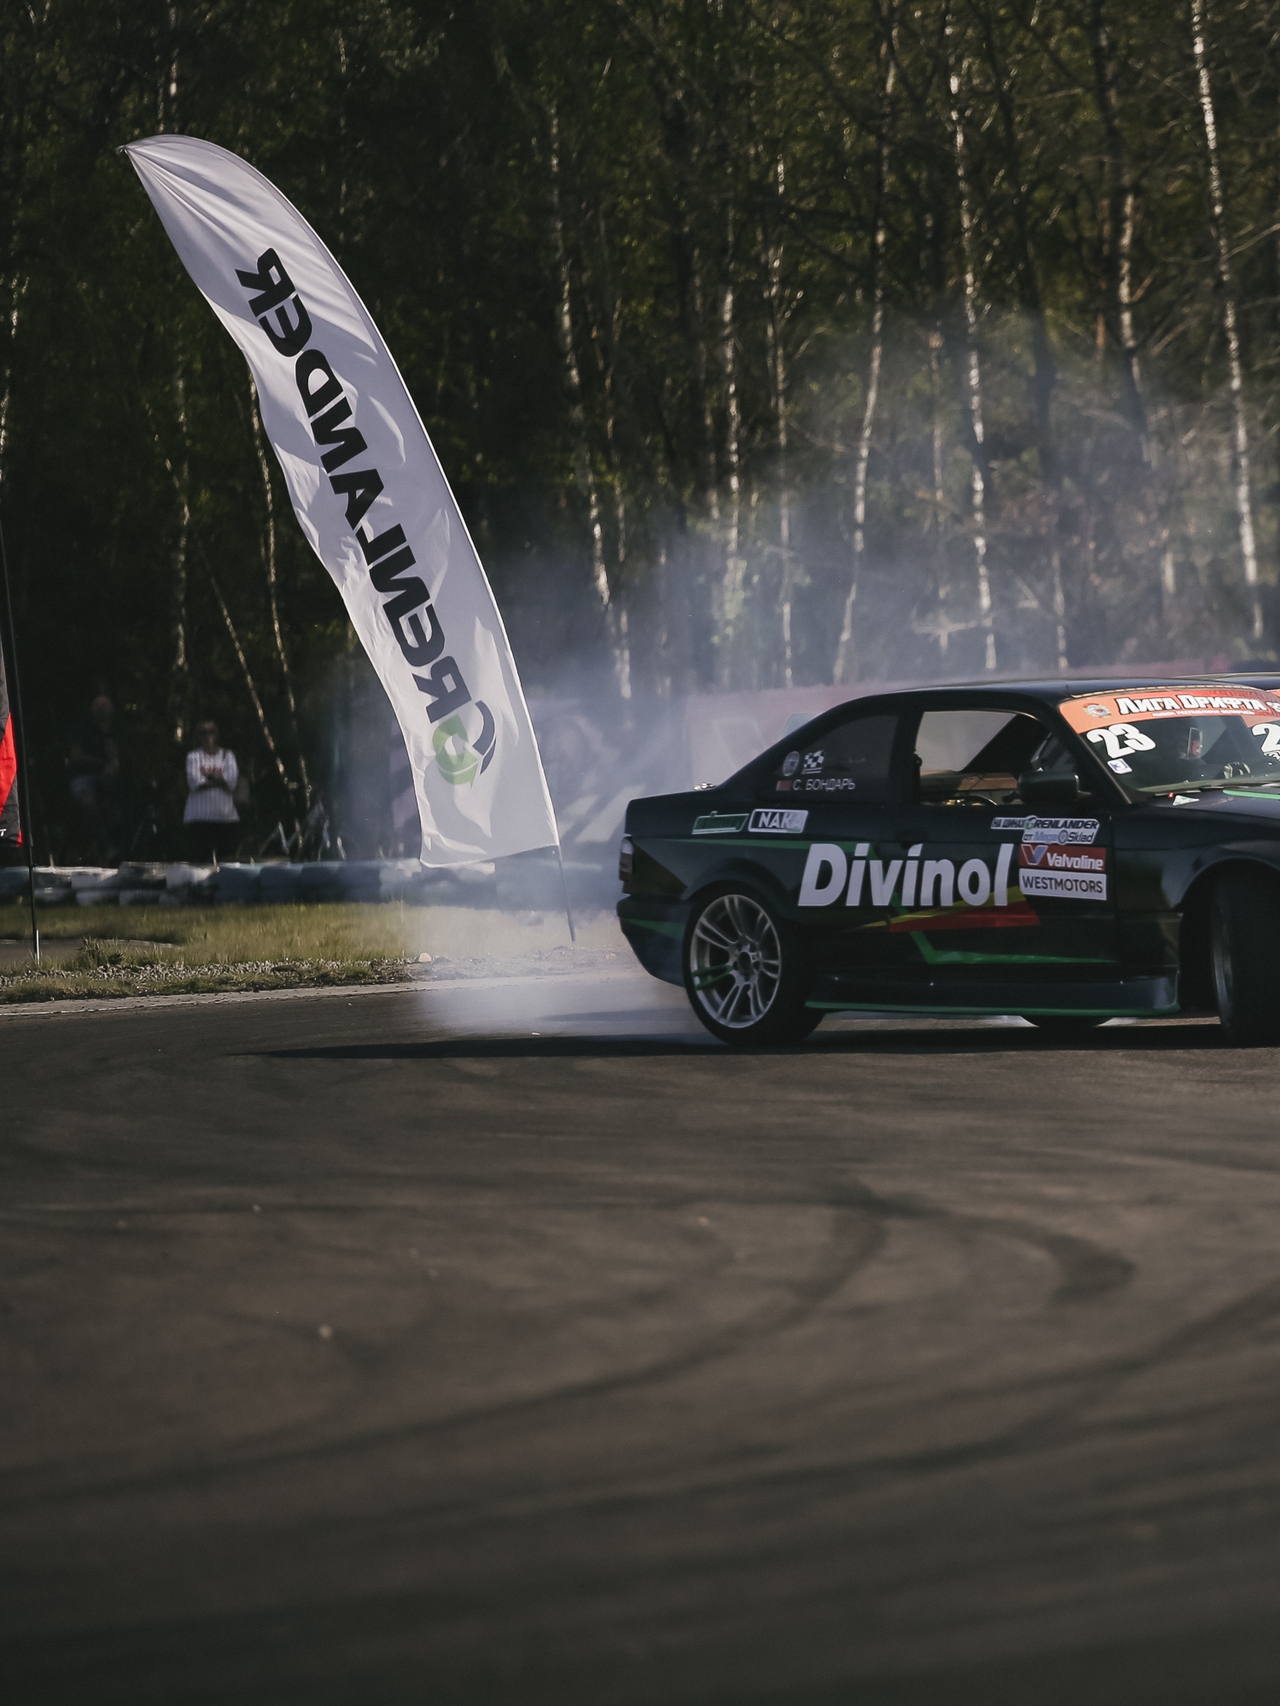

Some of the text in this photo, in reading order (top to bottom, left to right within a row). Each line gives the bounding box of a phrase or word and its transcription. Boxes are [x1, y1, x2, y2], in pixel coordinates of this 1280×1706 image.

[1086, 723, 1156, 759] 23
[805, 778, 855, 792] БОНДАРЬ
[1047, 852, 1104, 870] Valvoline
[798, 842, 1014, 907] Divinol
[1022, 875, 1103, 894] WESTMOTORS
